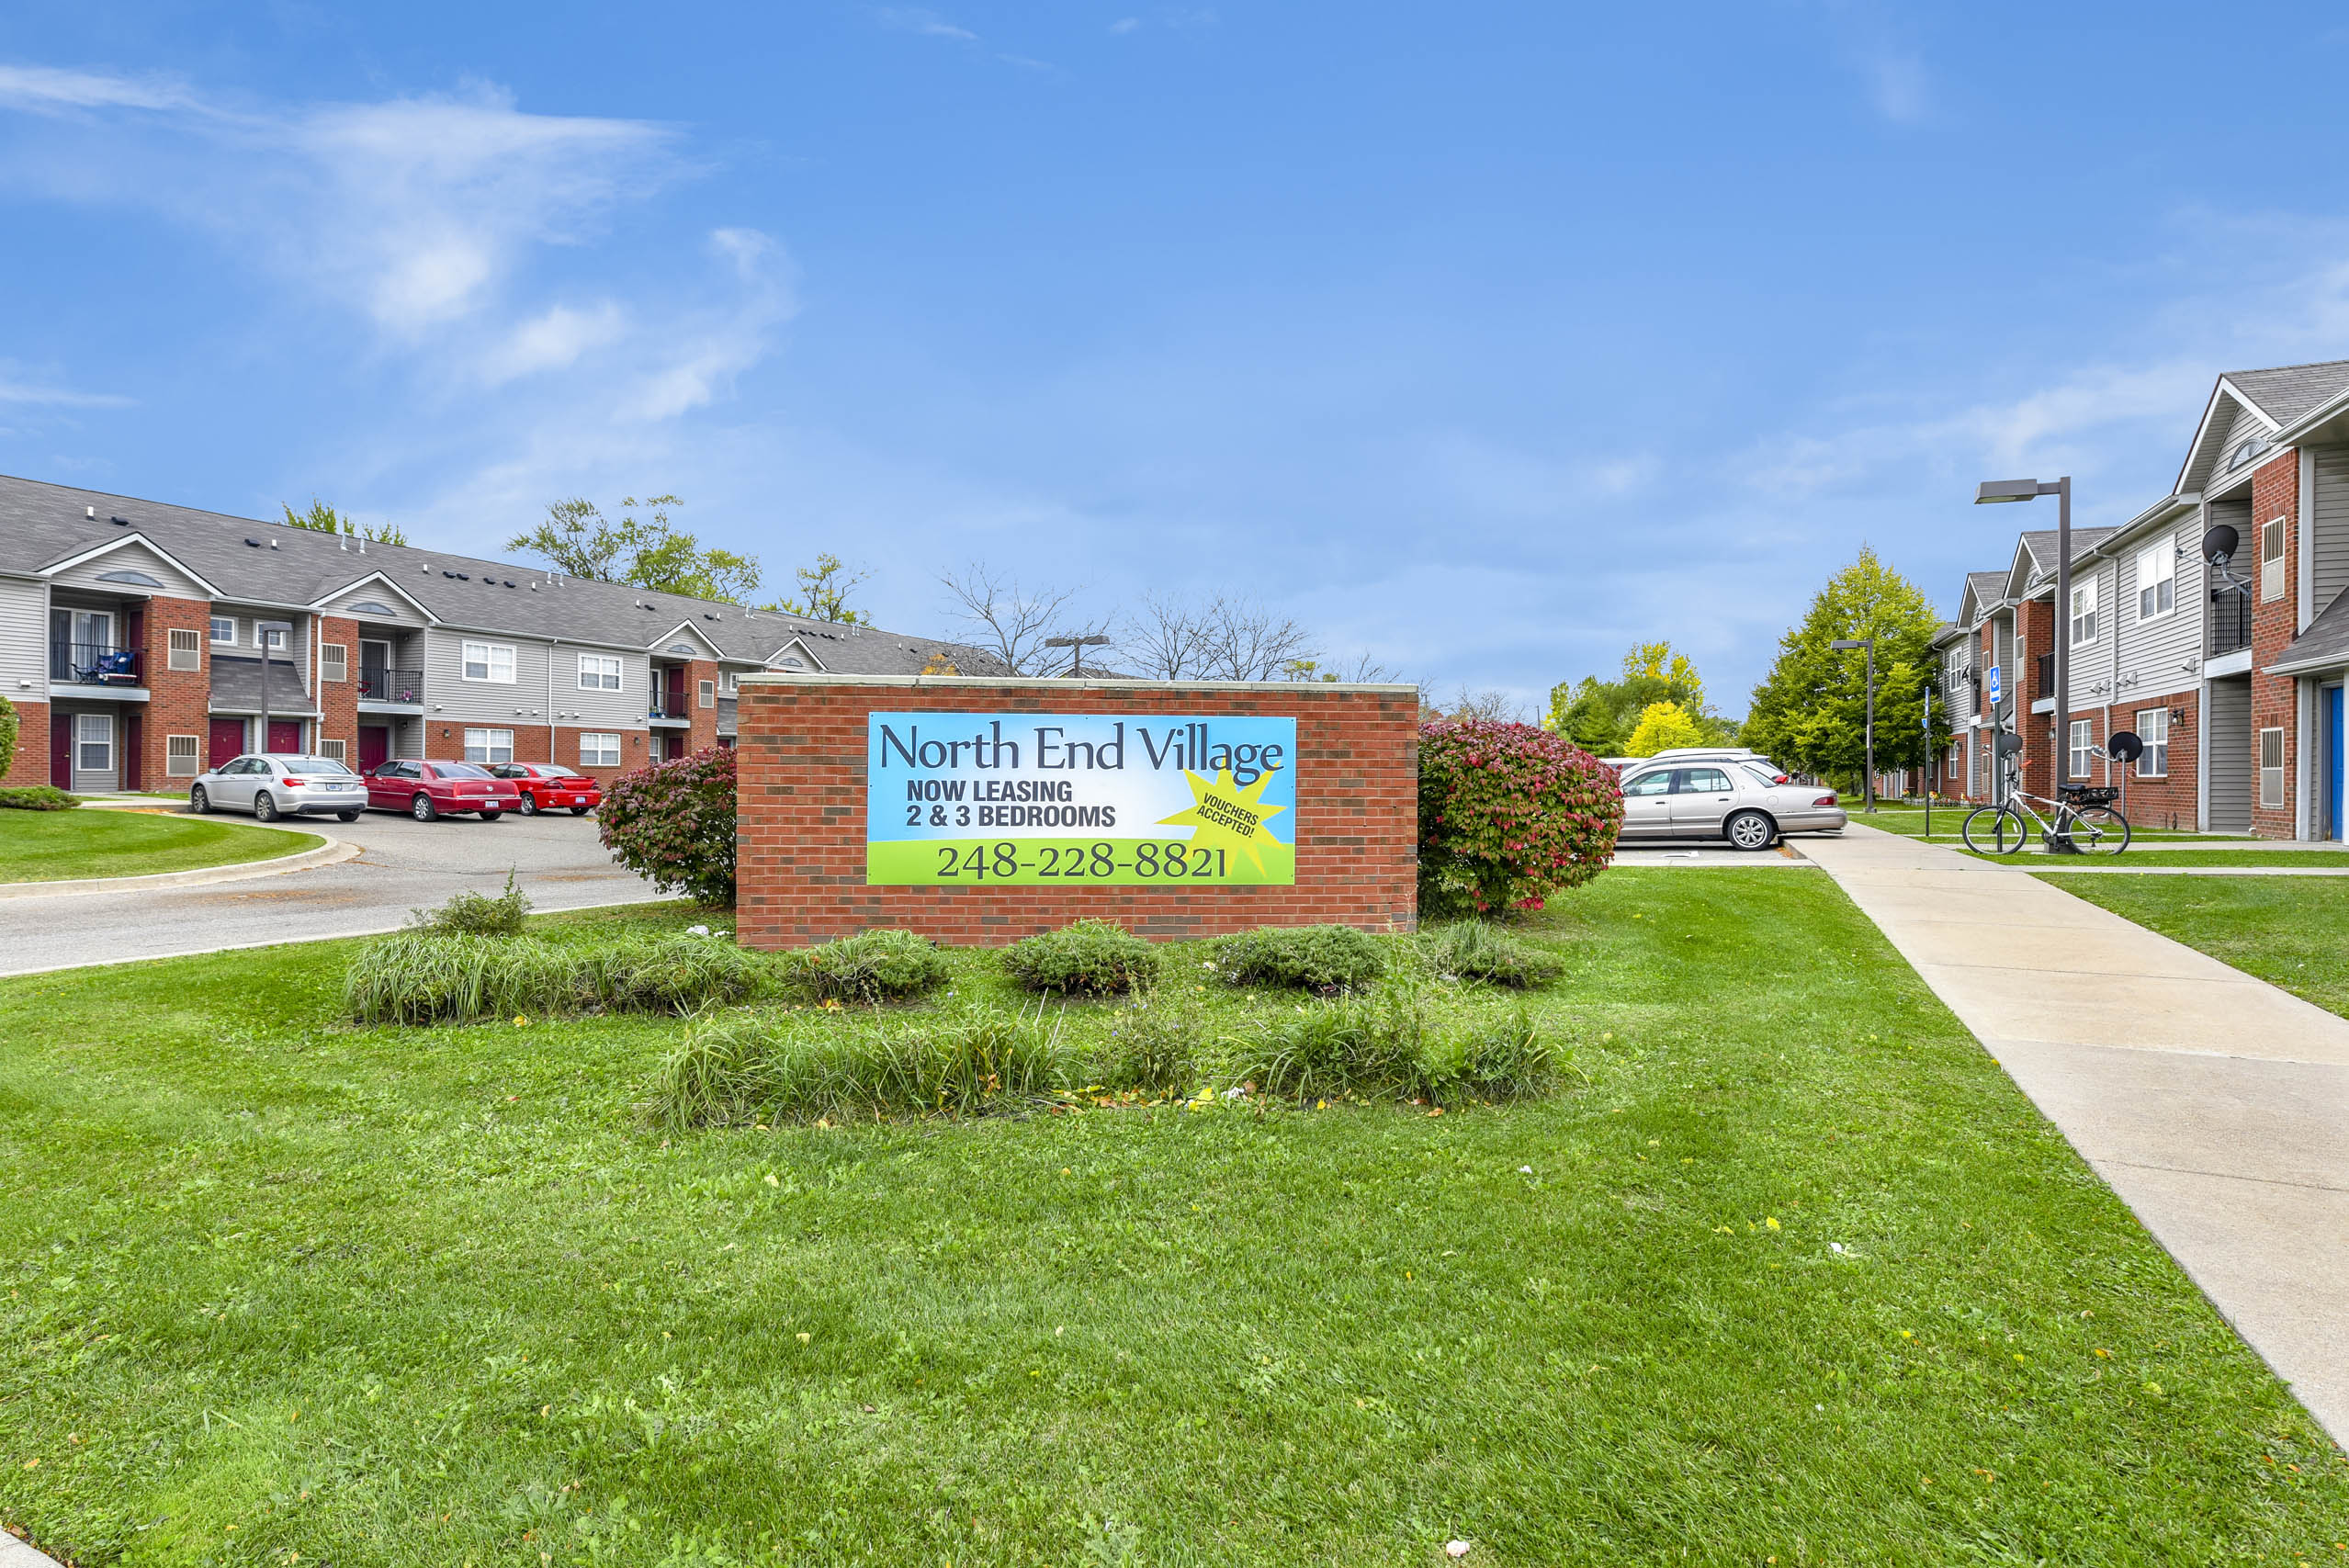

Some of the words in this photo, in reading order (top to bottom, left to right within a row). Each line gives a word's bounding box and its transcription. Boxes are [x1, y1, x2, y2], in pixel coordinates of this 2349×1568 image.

[880, 720, 1019, 769] North
[1033, 722, 1124, 770] End
[1136, 723, 1284, 786] Village
[907, 780, 966, 802] NOW
[973, 780, 1072, 803] LEASING
[906, 806, 921, 827] 2
[929, 805, 948, 827] &
[955, 806, 971, 827] 3
[978, 806, 1116, 828] BEDROOMS
[1196, 805, 1255, 839] ACCEPTED!
[1203, 792, 1259, 826] VOUCHERS
[936, 842, 1225, 879] 248-228-8821
